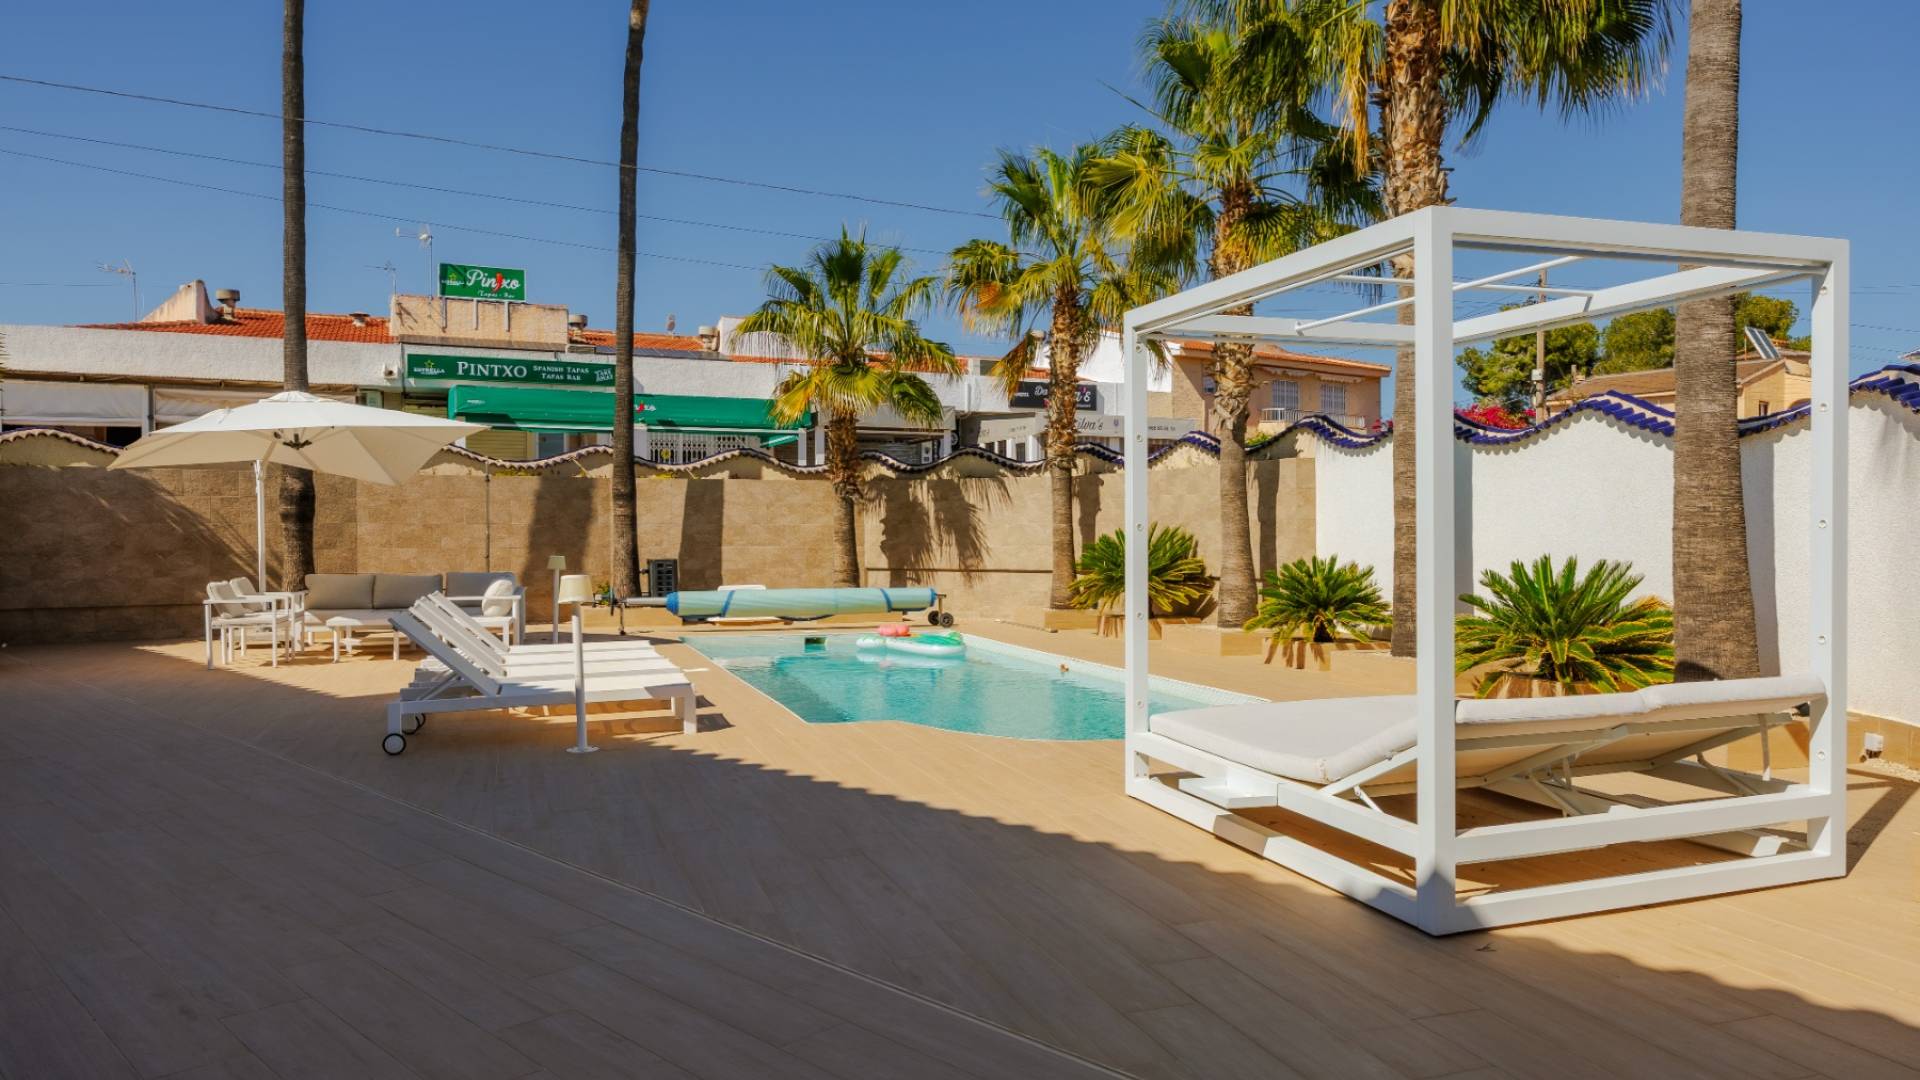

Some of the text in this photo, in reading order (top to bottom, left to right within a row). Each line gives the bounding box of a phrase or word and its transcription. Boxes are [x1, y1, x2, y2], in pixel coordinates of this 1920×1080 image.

[456, 361, 528, 378] PINTXO
[532, 365, 564, 373] SPANISH
[541, 372, 564, 380] TAPAS
